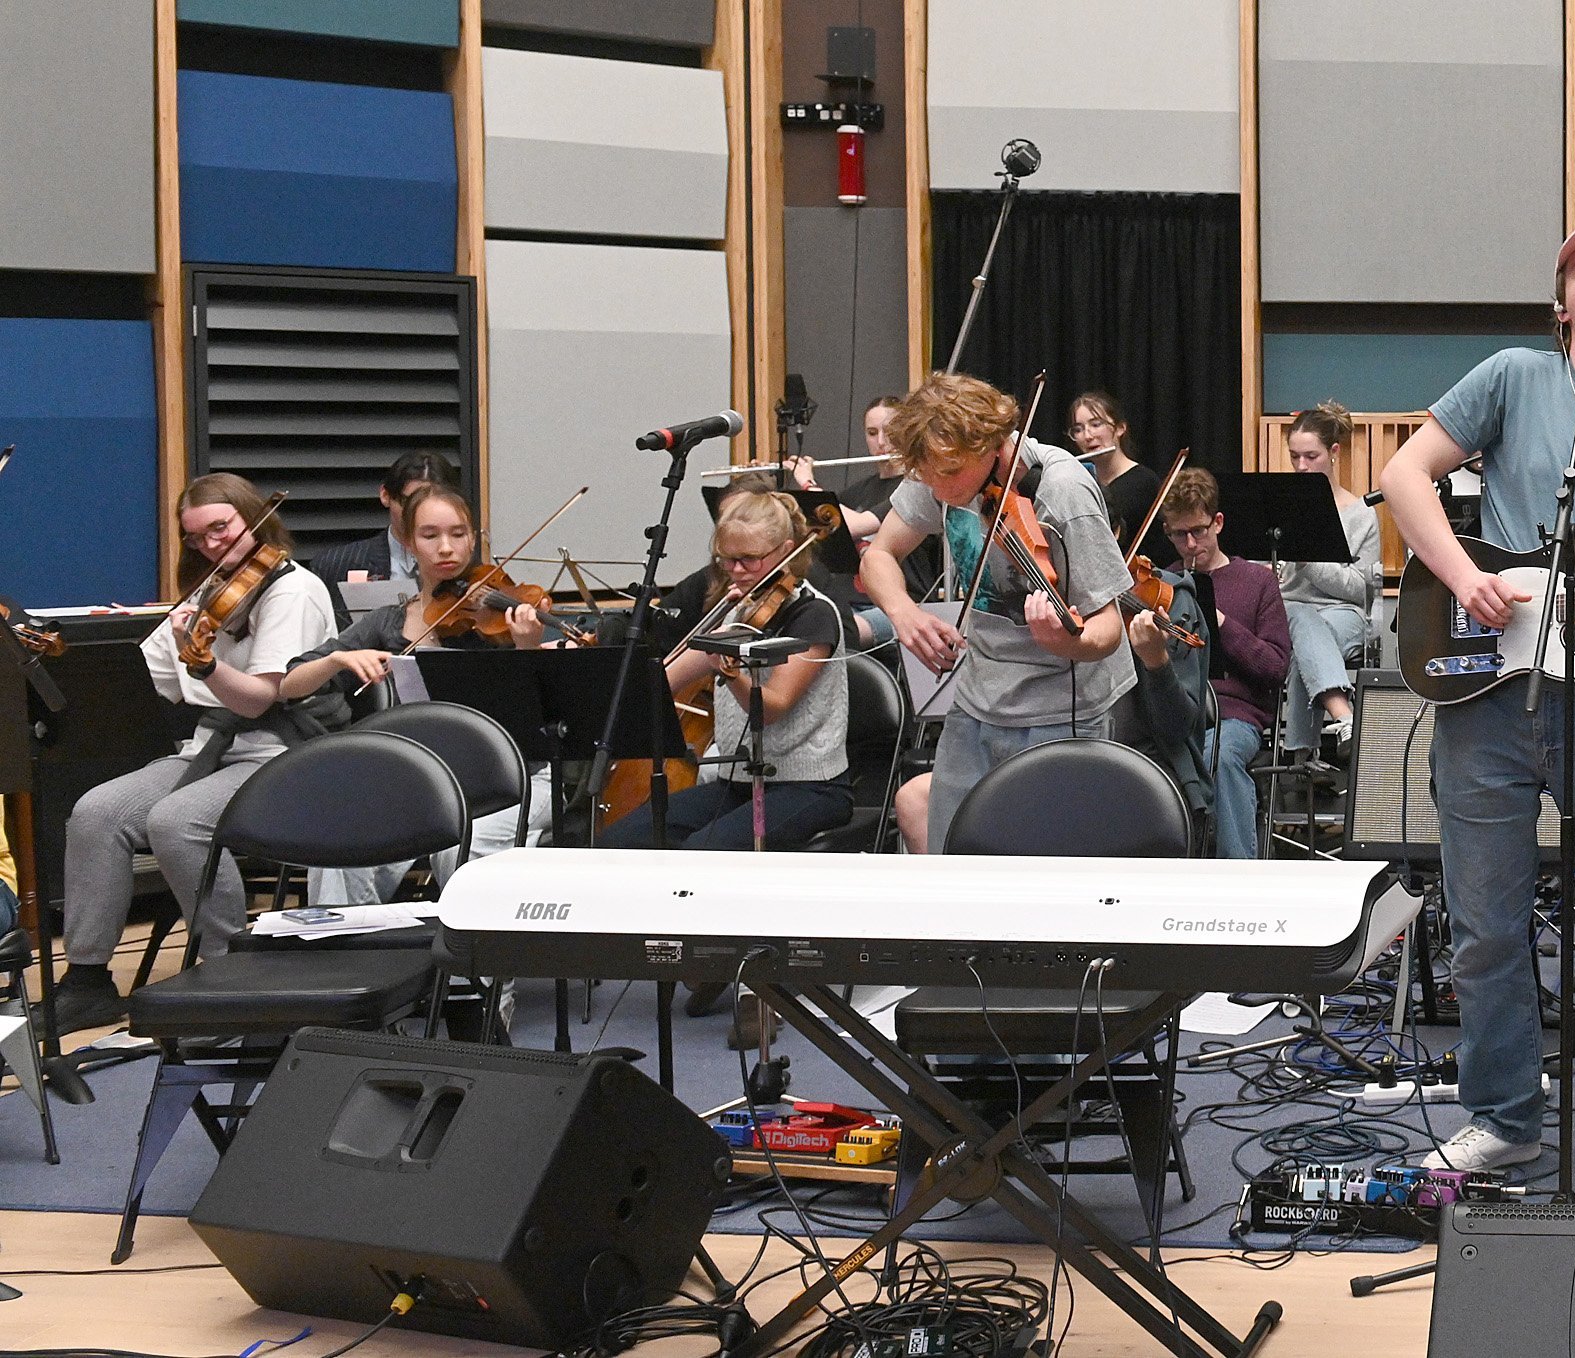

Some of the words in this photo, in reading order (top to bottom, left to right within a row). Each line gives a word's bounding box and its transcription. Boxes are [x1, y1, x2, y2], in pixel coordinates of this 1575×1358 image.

[514, 902, 572, 920] KORG
[1162, 918, 1268, 935] Grandstage
[1274, 919, 1287, 933] X
[772, 1131, 829, 1148] DigiTech
[833, 1245, 874, 1280] HERCULES
